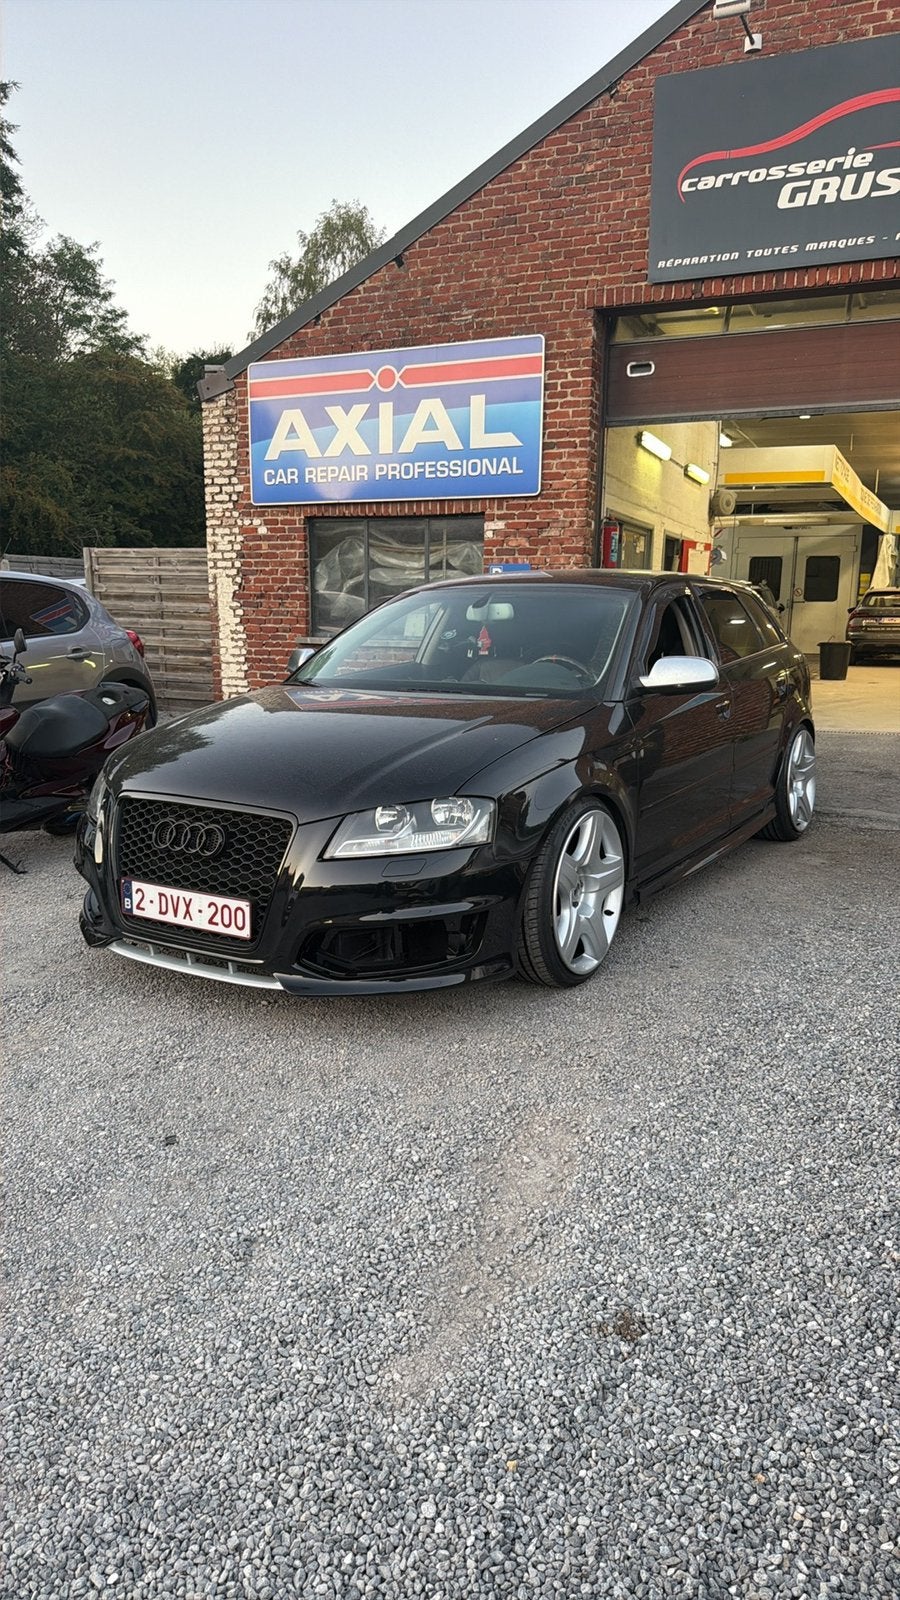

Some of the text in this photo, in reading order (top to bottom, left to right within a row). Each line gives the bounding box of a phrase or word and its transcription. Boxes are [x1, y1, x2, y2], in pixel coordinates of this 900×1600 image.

[681, 147, 874, 193] carrosserie
[657, 251, 740, 269] RÉPARATION
[746, 244, 799, 258] TOUTES
[805, 235, 876, 251] MARQUES
[264, 394, 524, 461] AXIAL
[263, 456, 524, 486] CAR REPAIR PROFESSIONAL
[124, 887, 246, 931] B 2-DVX-200
